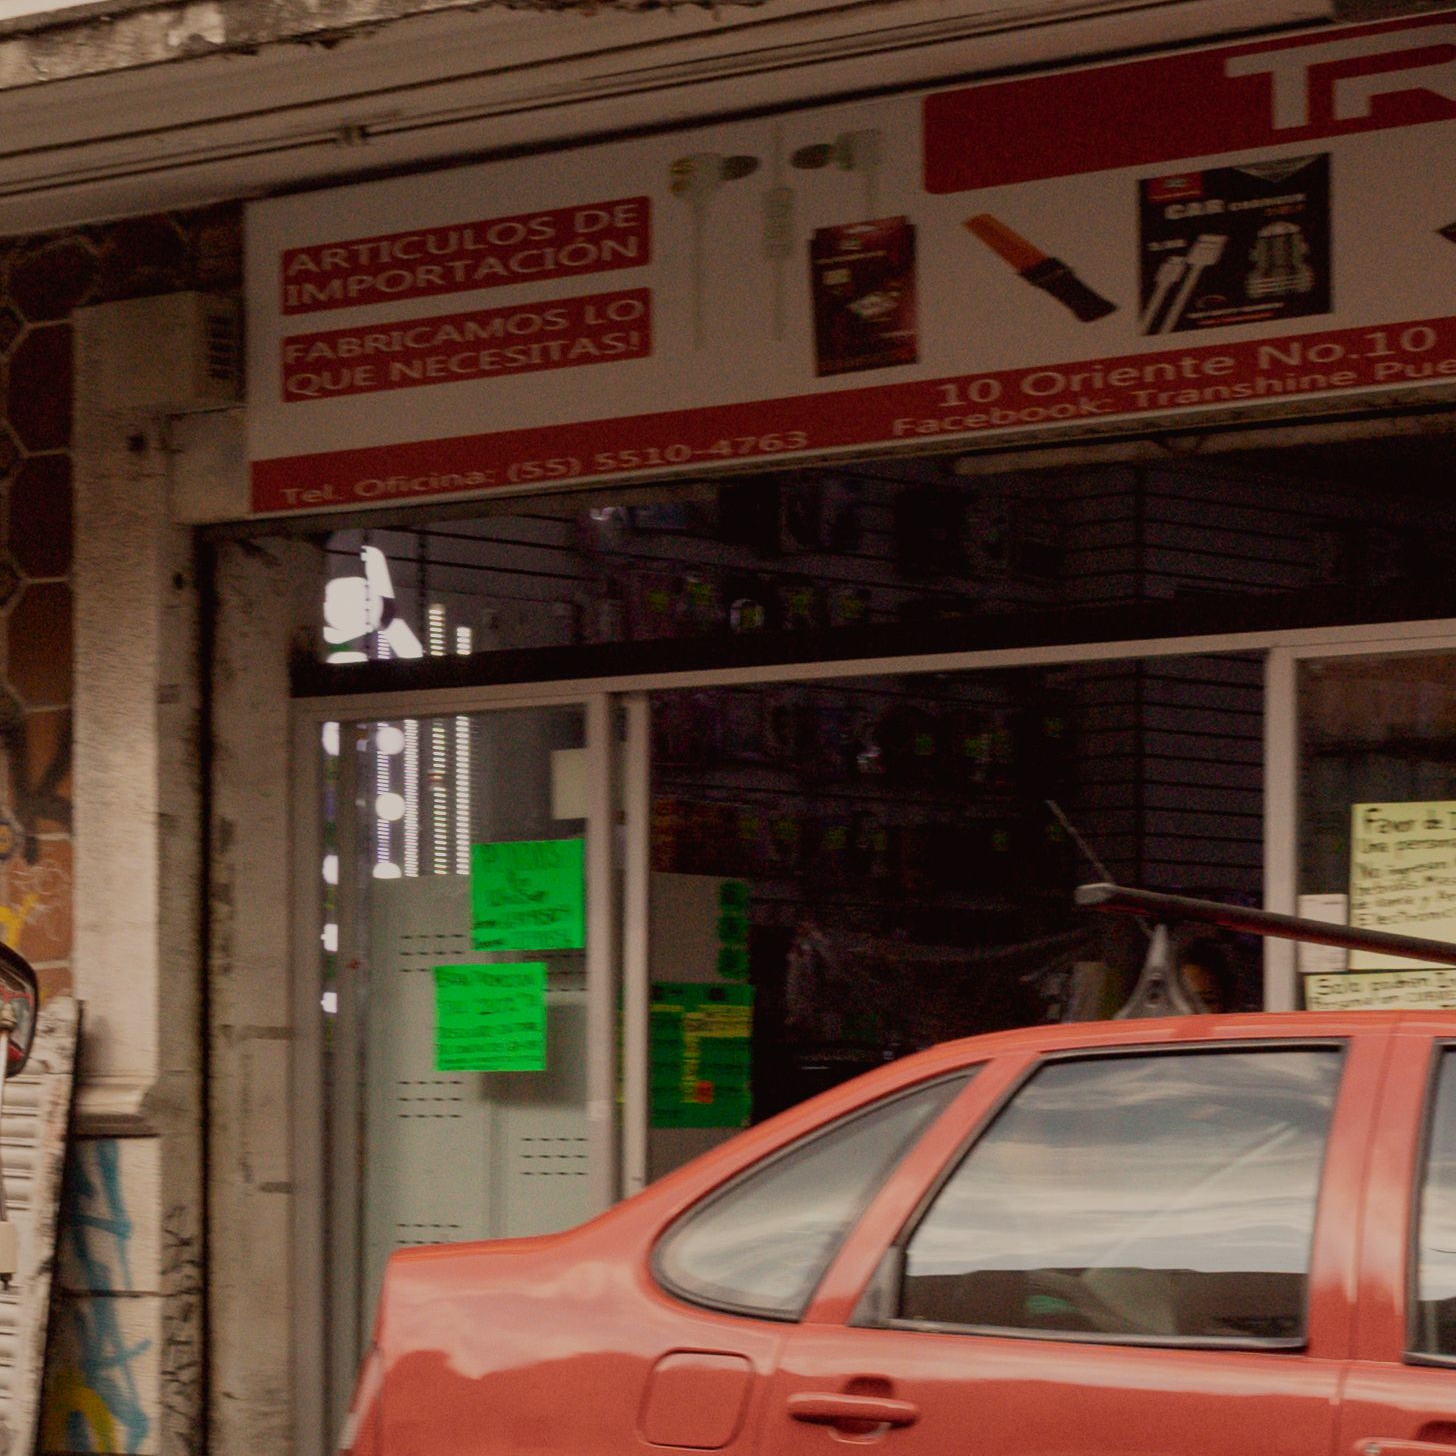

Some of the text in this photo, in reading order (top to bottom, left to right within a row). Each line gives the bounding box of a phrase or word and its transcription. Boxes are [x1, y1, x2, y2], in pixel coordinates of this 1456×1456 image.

[287, 204, 641, 277] ARTICULOS DE
[286, 299, 645, 365] FABRICAMOS LO
[286, 329, 641, 398] QUE NECESITAS!
[937, 378, 1003, 407] 10
[1020, 353, 1236, 396] Oriente
[1131, 372, 1359, 409] Transhine
[282, 485, 344, 507] Tel.
[353, 469, 496, 500] Oficina:
[507, 456, 582, 485] (55)
